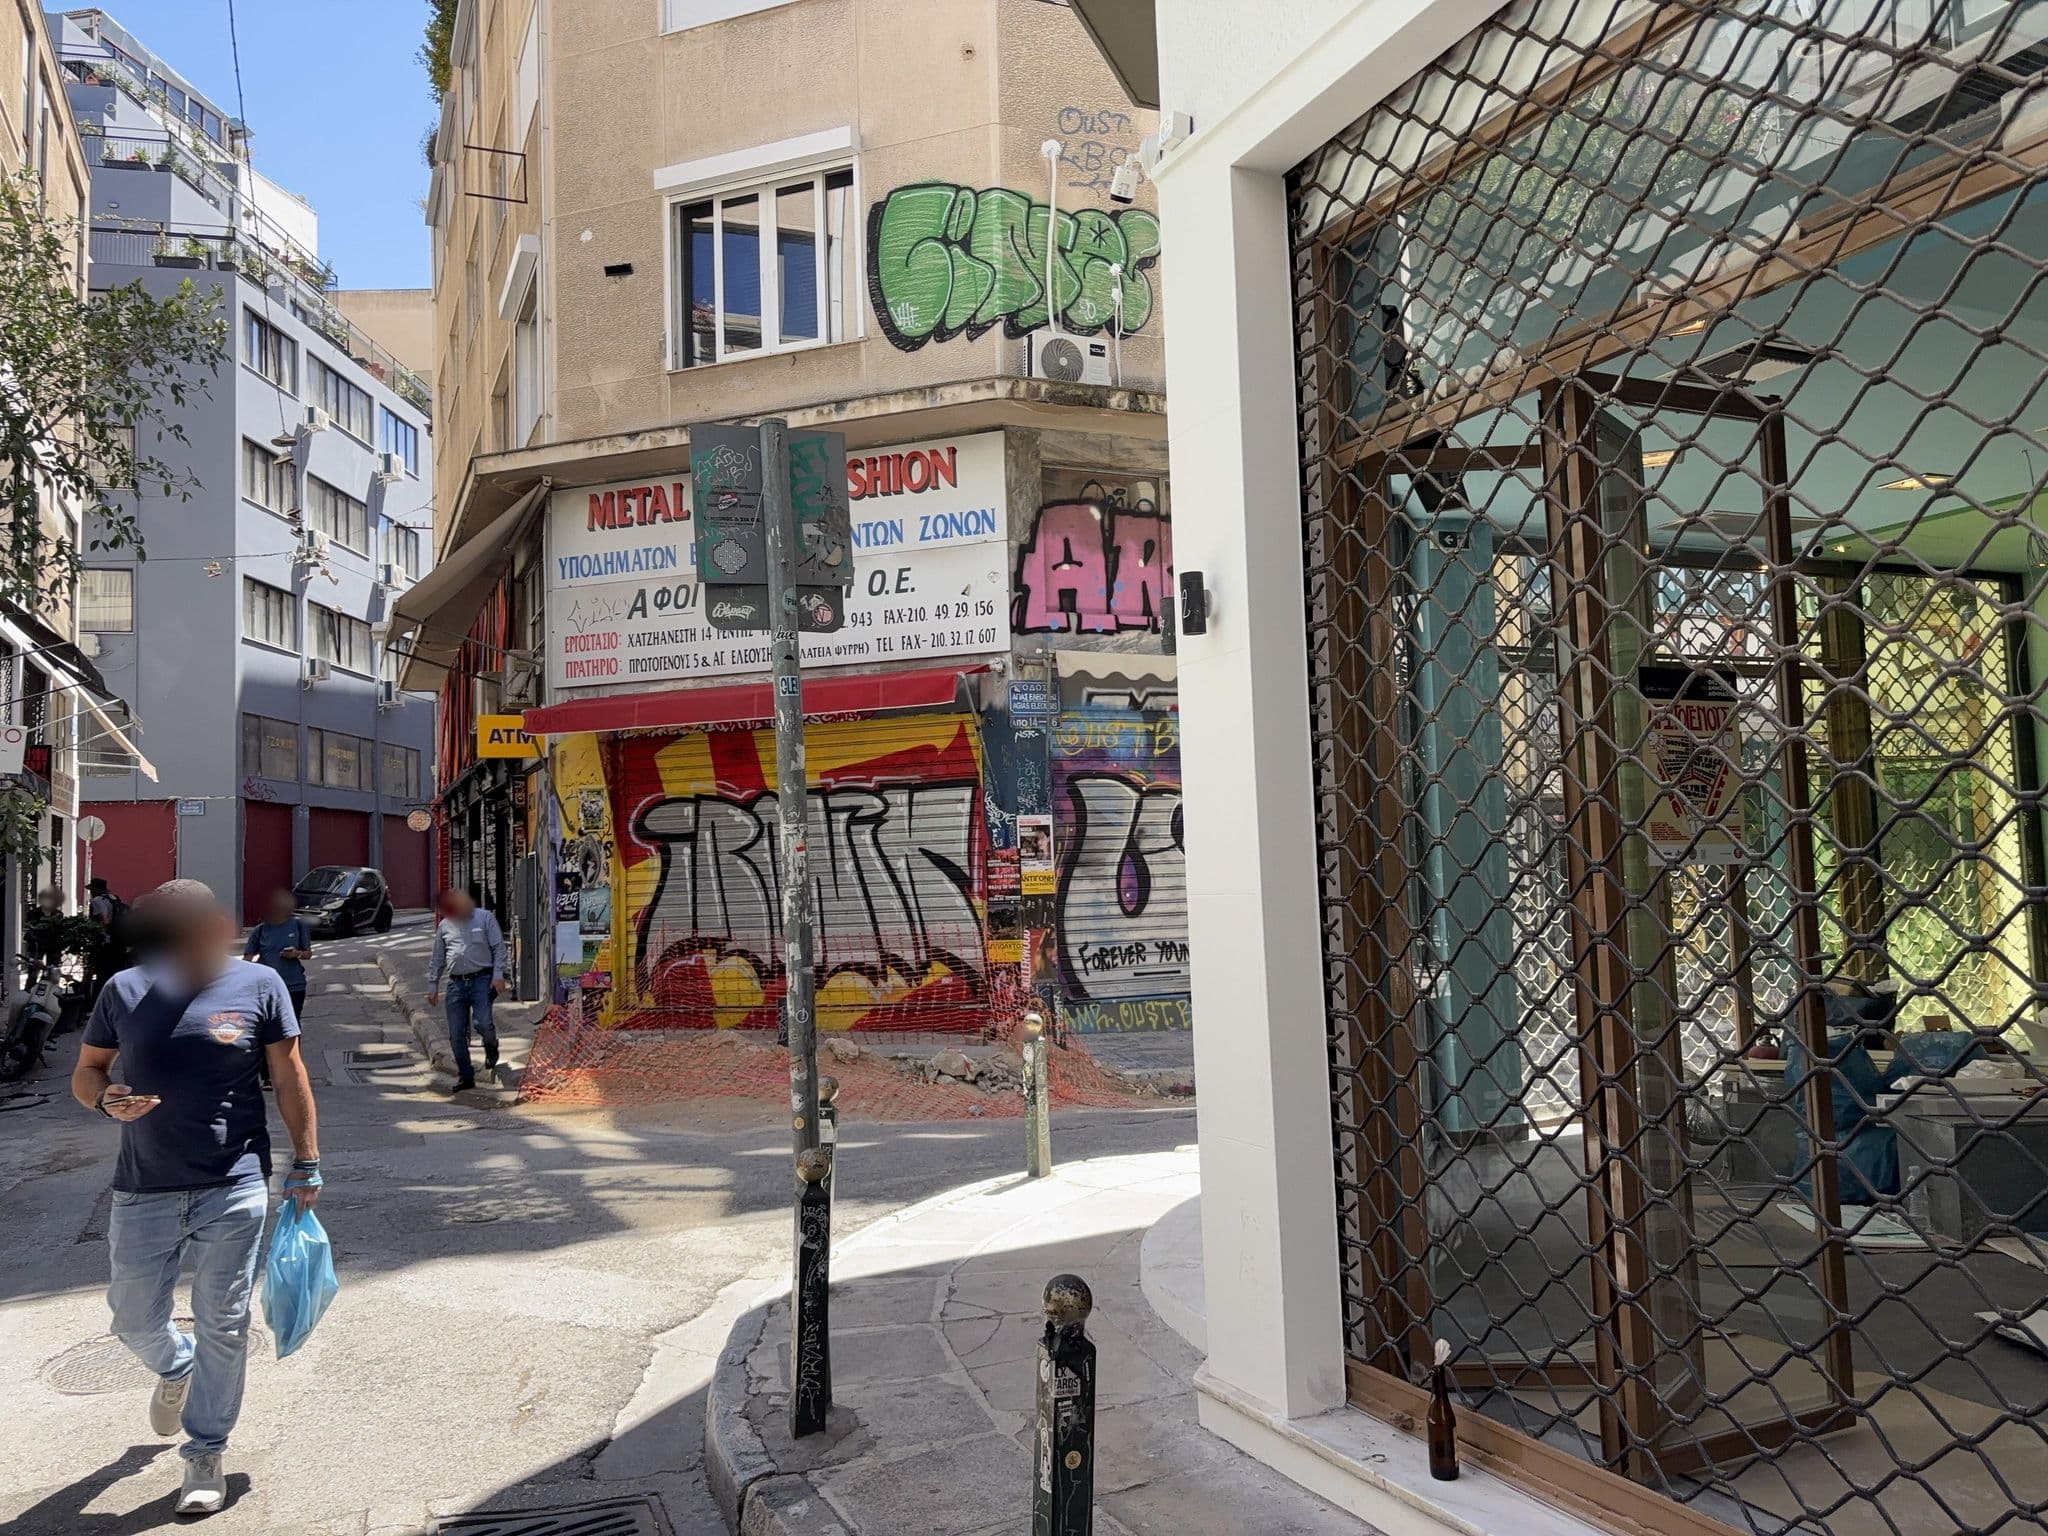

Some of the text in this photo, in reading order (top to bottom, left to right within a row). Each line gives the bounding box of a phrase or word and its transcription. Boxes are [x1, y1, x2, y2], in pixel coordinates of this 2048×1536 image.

[586, 482, 691, 532] METAL
[558, 544, 678, 580] ΥΠΟΔΗΜΑΤΩΝ
[919, 508, 996, 542] ΖΩΝΩΝ
[867, 567, 916, 597] Ο.Ε.
[564, 631, 623, 654] ΕΡΓΟΣΤΑΣΙΟ:
[627, 627, 698, 649] ΧΑΤΖΗΑΝΕΣΤΗ
[701, 626, 713, 642] 14
[851, 612, 872, 628] 943
[975, 600, 994, 617] 156
[565, 656, 624, 680] ΠΡΑΤΗΡΙΟ:
[629, 653, 691, 675] ΠΡΩΤΟΓΕΝΟΥΣ
[701, 656, 712, 668] &
[876, 637, 894, 653] TEL
